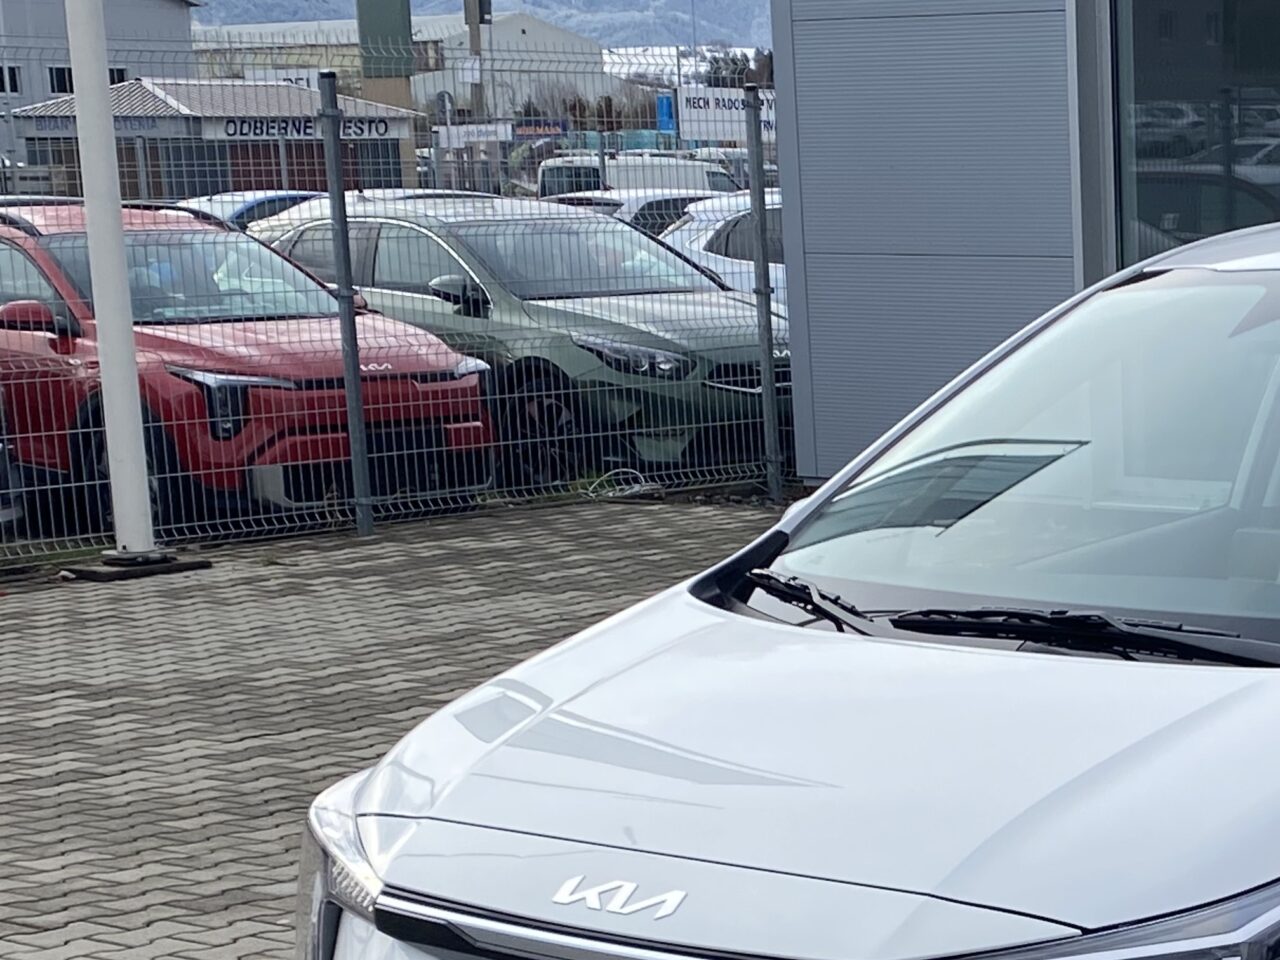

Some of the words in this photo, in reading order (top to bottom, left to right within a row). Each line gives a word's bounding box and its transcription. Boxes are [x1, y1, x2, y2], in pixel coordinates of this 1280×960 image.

[225, 118, 314, 137] ODBERNE
[342, 118, 389, 137] ESTO
[552, 874, 688, 921] KIA
